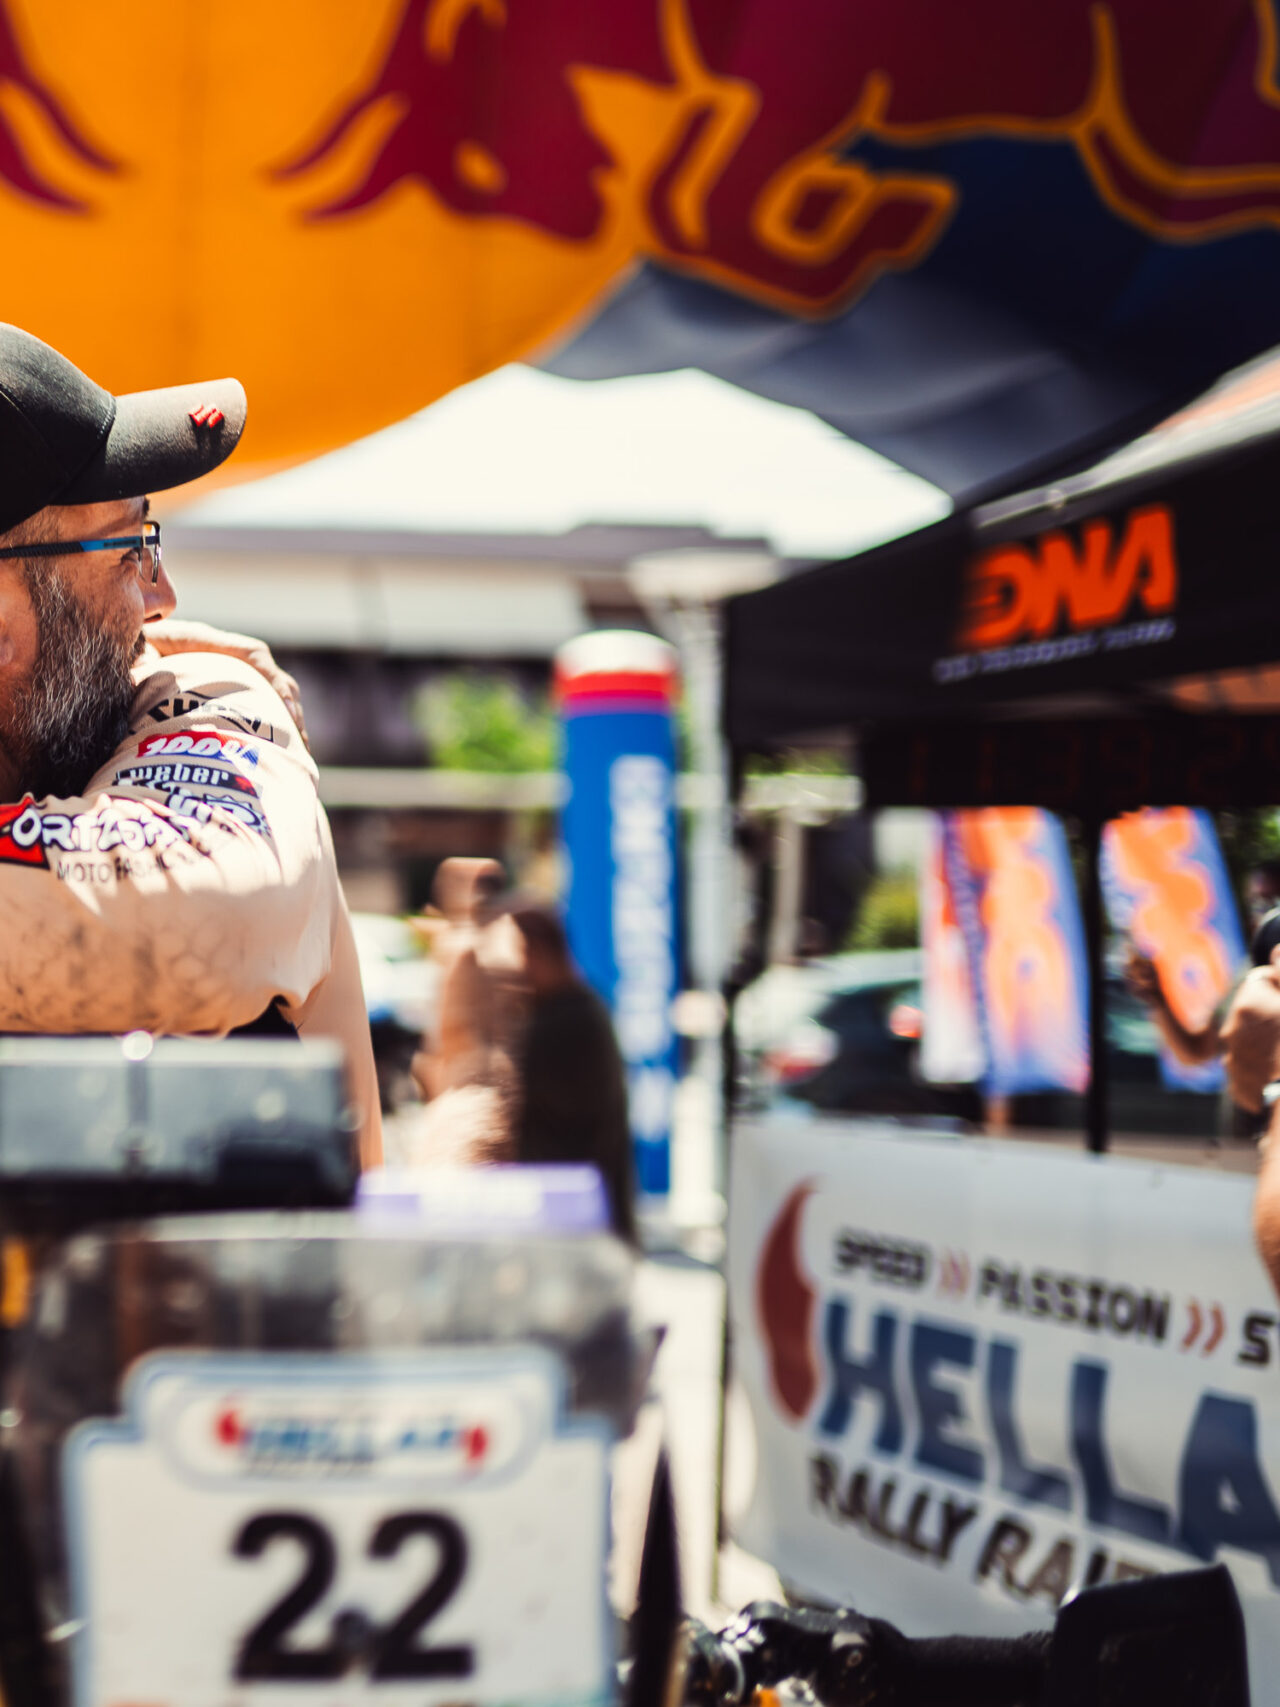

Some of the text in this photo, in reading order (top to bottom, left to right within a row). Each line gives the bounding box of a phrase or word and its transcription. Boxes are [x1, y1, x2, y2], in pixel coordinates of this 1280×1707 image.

[960, 506, 1175, 648] DNA
[835, 1232, 927, 1286] SPEED
[979, 1258, 1171, 1342] PASSION
[810, 1452, 978, 1565] RALLY
[230, 1509, 475, 1682] 22
